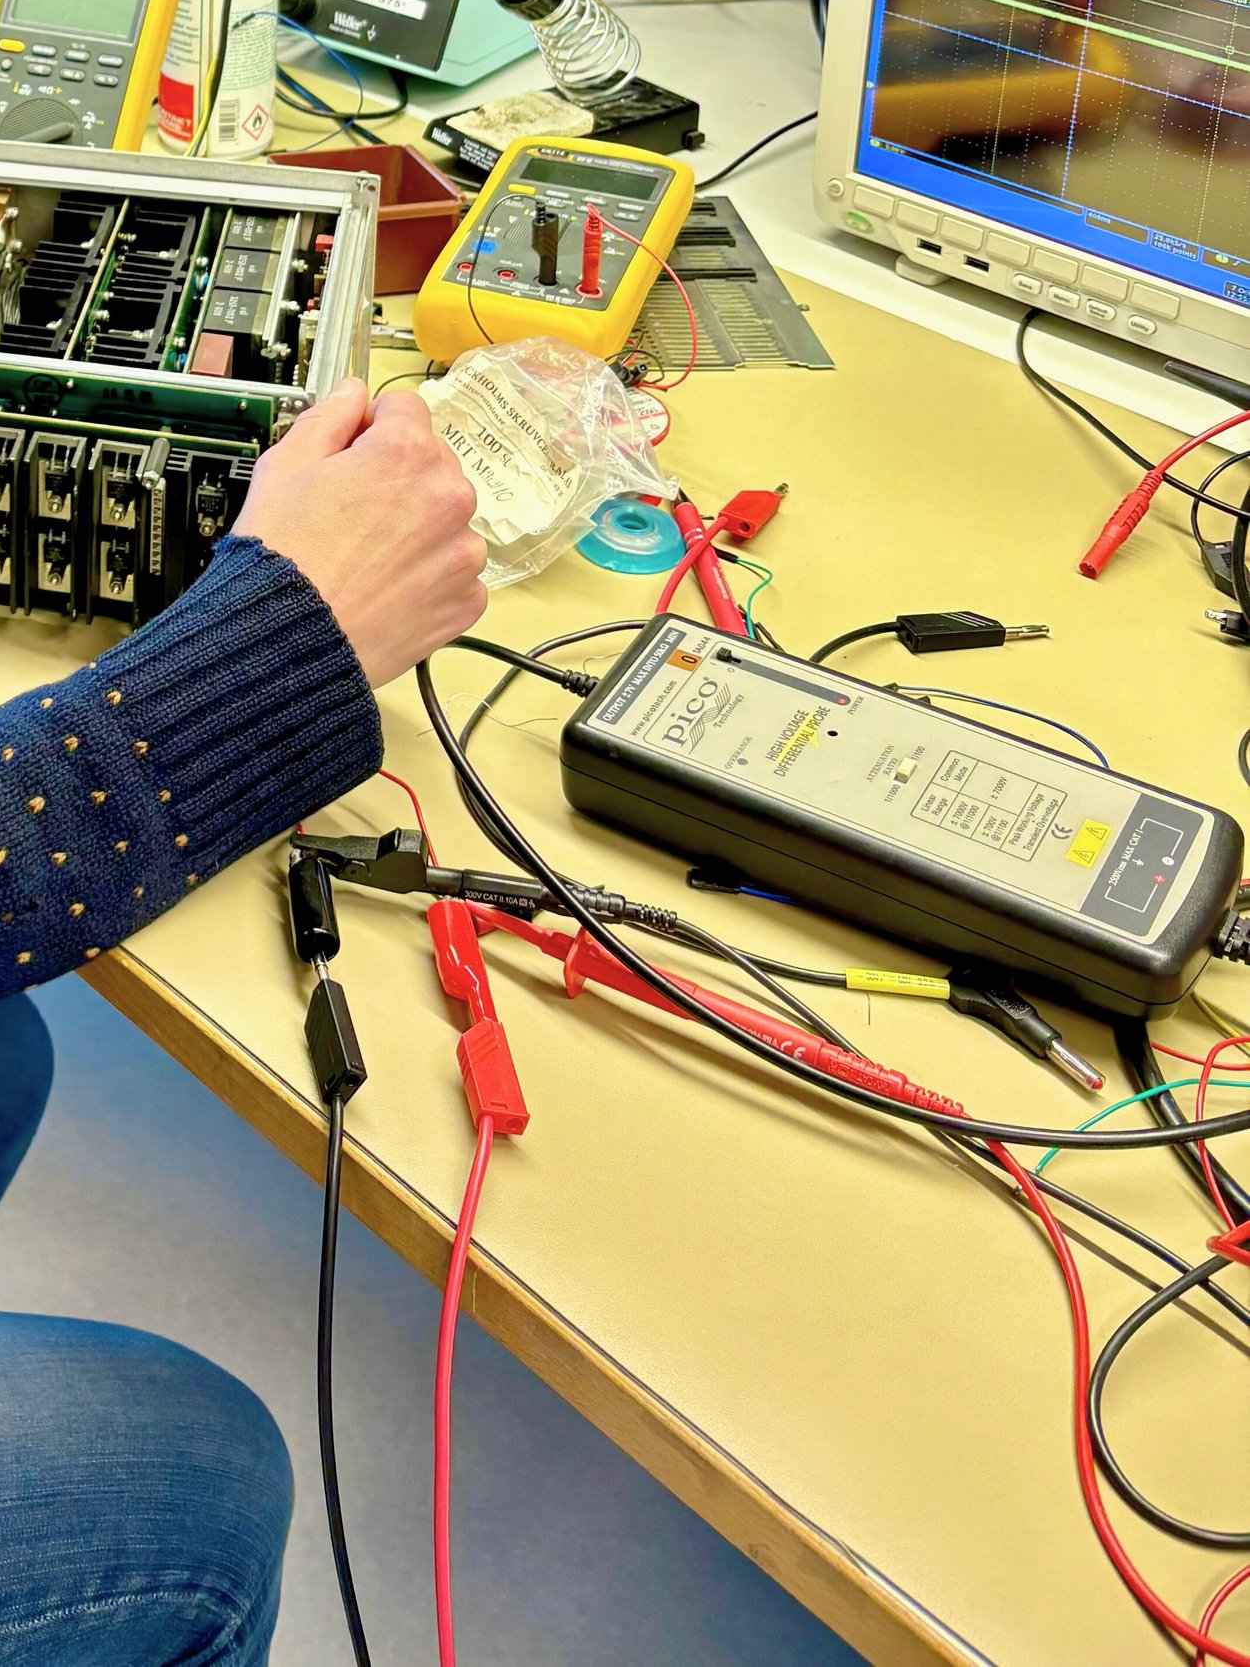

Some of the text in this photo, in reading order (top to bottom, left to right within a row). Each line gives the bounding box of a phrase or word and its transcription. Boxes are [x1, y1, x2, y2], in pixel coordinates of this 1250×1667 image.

[1087, 212, 1111, 224] 400ms
[1172, 245, 1196, 260] points
[441, 422, 477, 459] MRT
[477, 426, 502, 454] 100
[602, 696, 627, 722] OUTPUT
[631, 669, 649, 686] MAX
[643, 655, 660, 675] INTO
[664, 630, 680, 644] MIN
[630, 680, 678, 737] www.picotech.com
[661, 679, 719, 748] pico
[713, 693, 746, 729] Technology
[847, 695, 865, 716] POWER
[765, 708, 810, 762] HIGH VOLTAGE
[773, 705, 831, 778] DIFFERENTIAL PROBE
[724, 735, 753, 770] OVERRANGE
[866, 743, 895, 783] ATTENUATION
[882, 757, 899, 777] RATIO
[940, 757, 961, 782] Common
[953, 765, 969, 783] Mode
[884, 784, 901, 804] 1/1000
[993, 776, 1008, 794] 7000V
[921, 793, 937, 812] Linear
[933, 797, 949, 817] Range
[954, 801, 969, 820] 7000V
[959, 804, 980, 831] @1/1000
[983, 815, 998, 833] 700V
[990, 818, 1009, 842] @1/100
[1008, 792, 1045, 847] Peak Working Voltage
[1022, 797, 1060, 853] Transient Overvoltage
[1121, 845, 1135, 861] MAX
[1129, 832, 1143, 847] CAT
[464, 890, 483, 900] 300V
[483, 893, 498, 902] CAT
[505, 896, 518, 905] 10A
